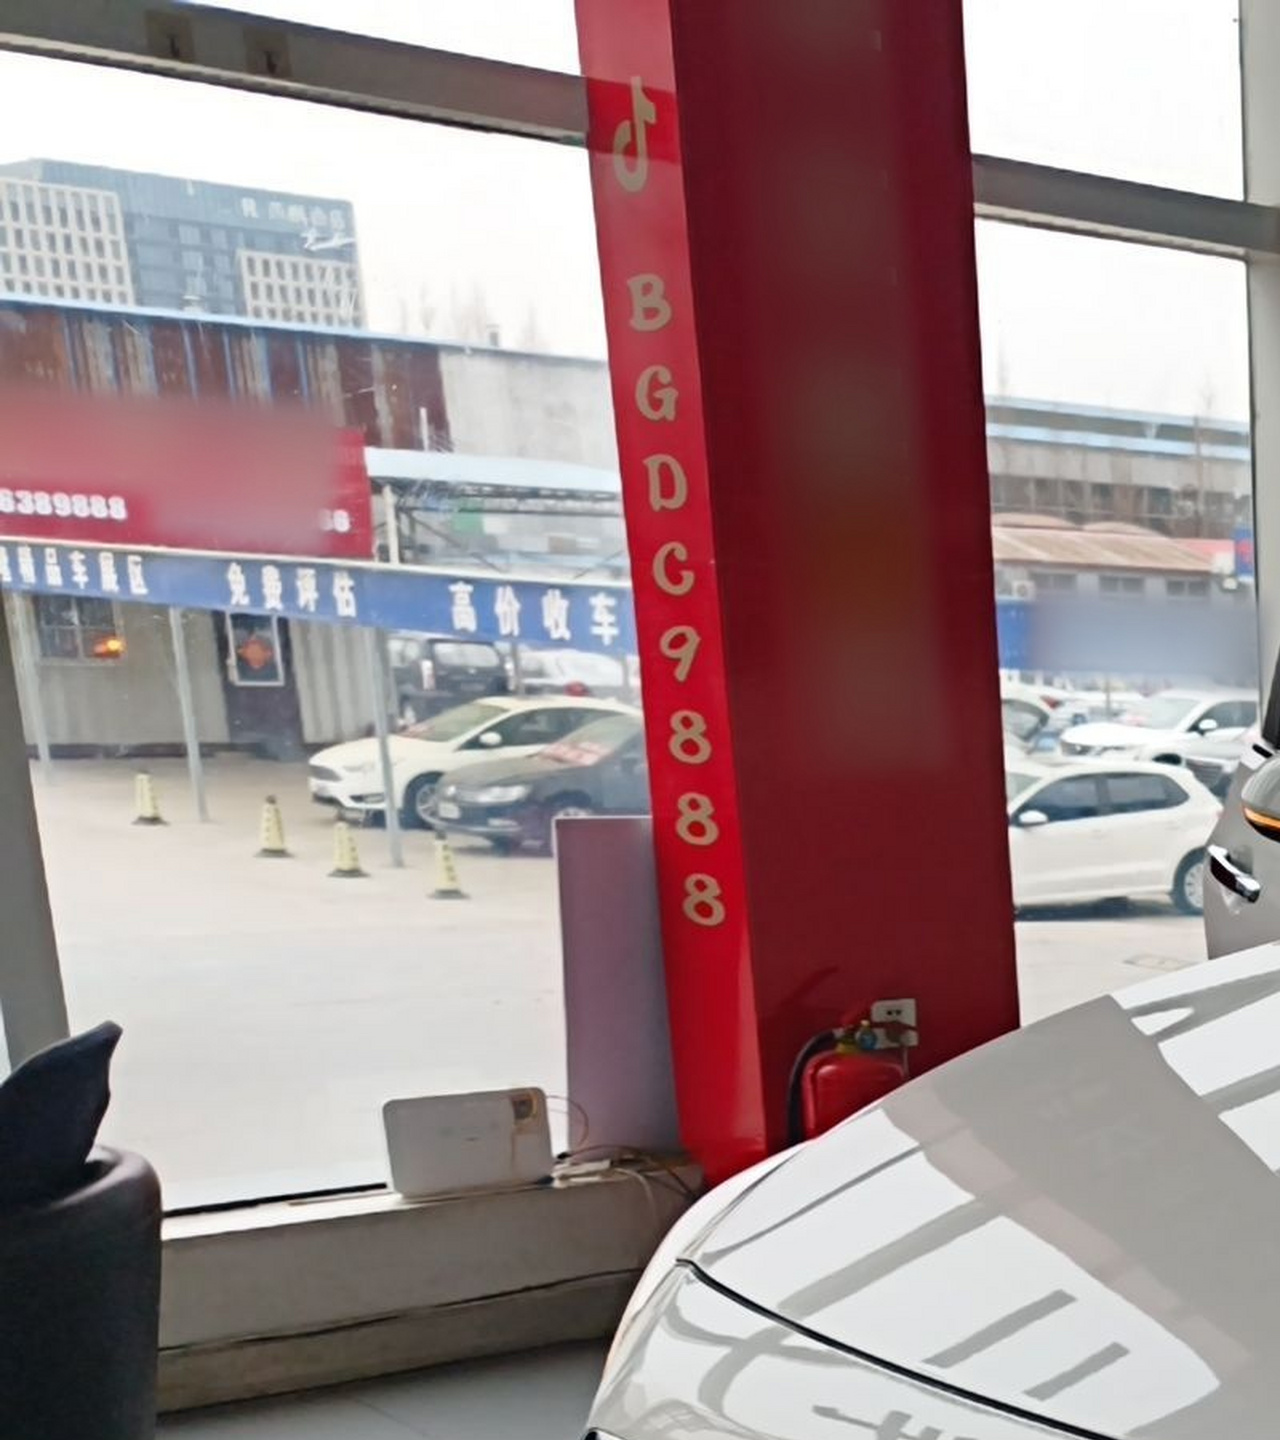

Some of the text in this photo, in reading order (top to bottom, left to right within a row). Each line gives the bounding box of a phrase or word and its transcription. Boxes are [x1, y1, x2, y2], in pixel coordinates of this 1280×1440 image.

[227, 562, 358, 618] 免费评估
[448, 580, 620, 646] 高价收车
